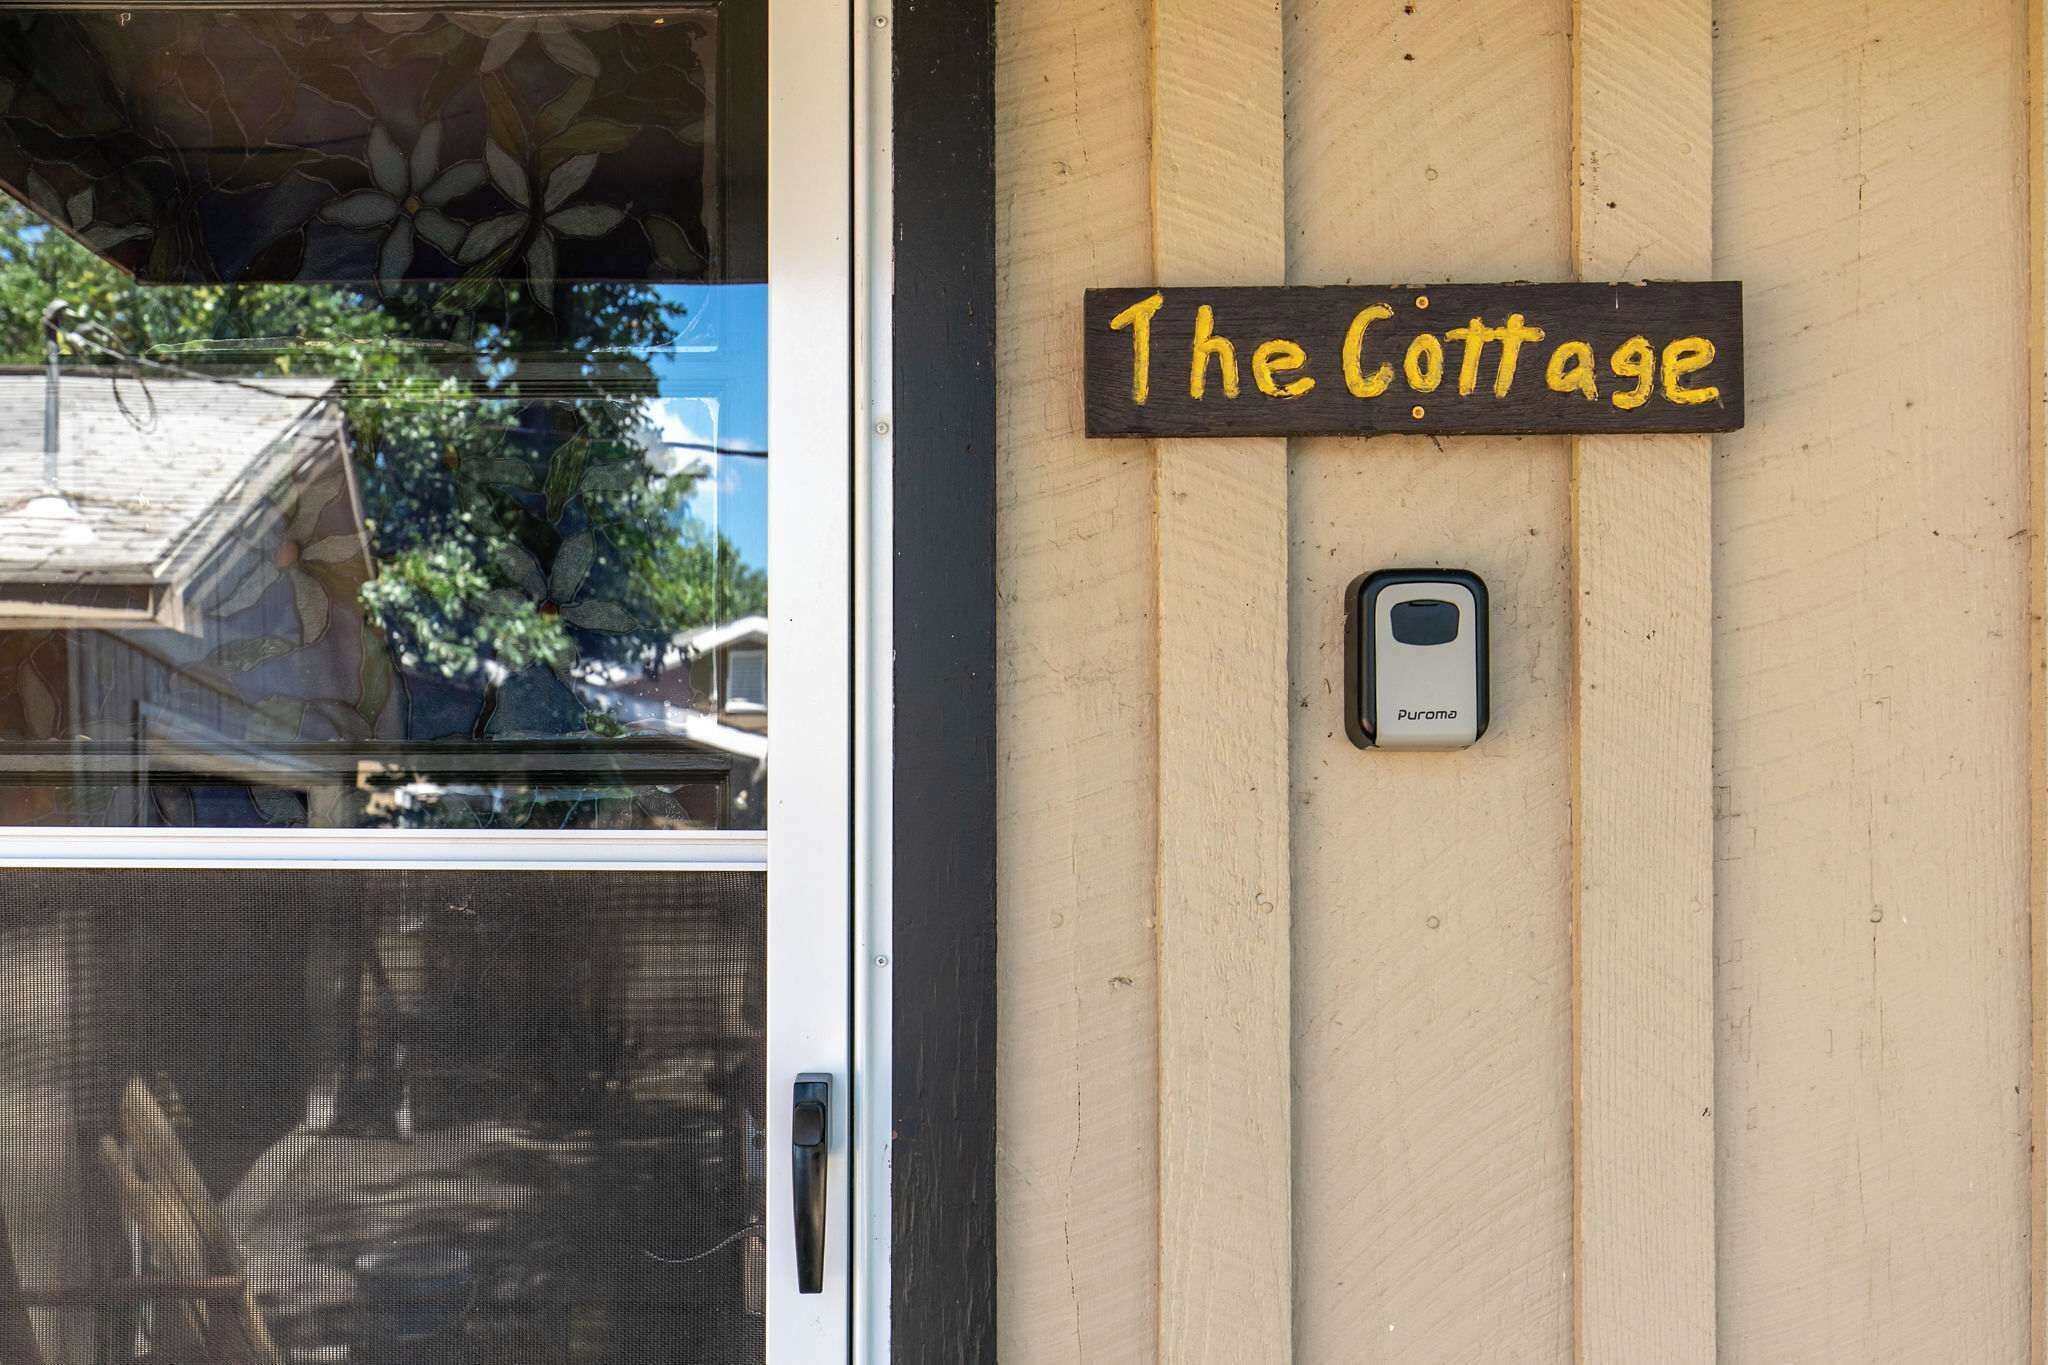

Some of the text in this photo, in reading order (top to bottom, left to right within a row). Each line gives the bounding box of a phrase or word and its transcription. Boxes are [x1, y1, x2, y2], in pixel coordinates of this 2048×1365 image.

[1110, 293, 1721, 410] The Cottage
[1397, 709, 1458, 721] Puroma
